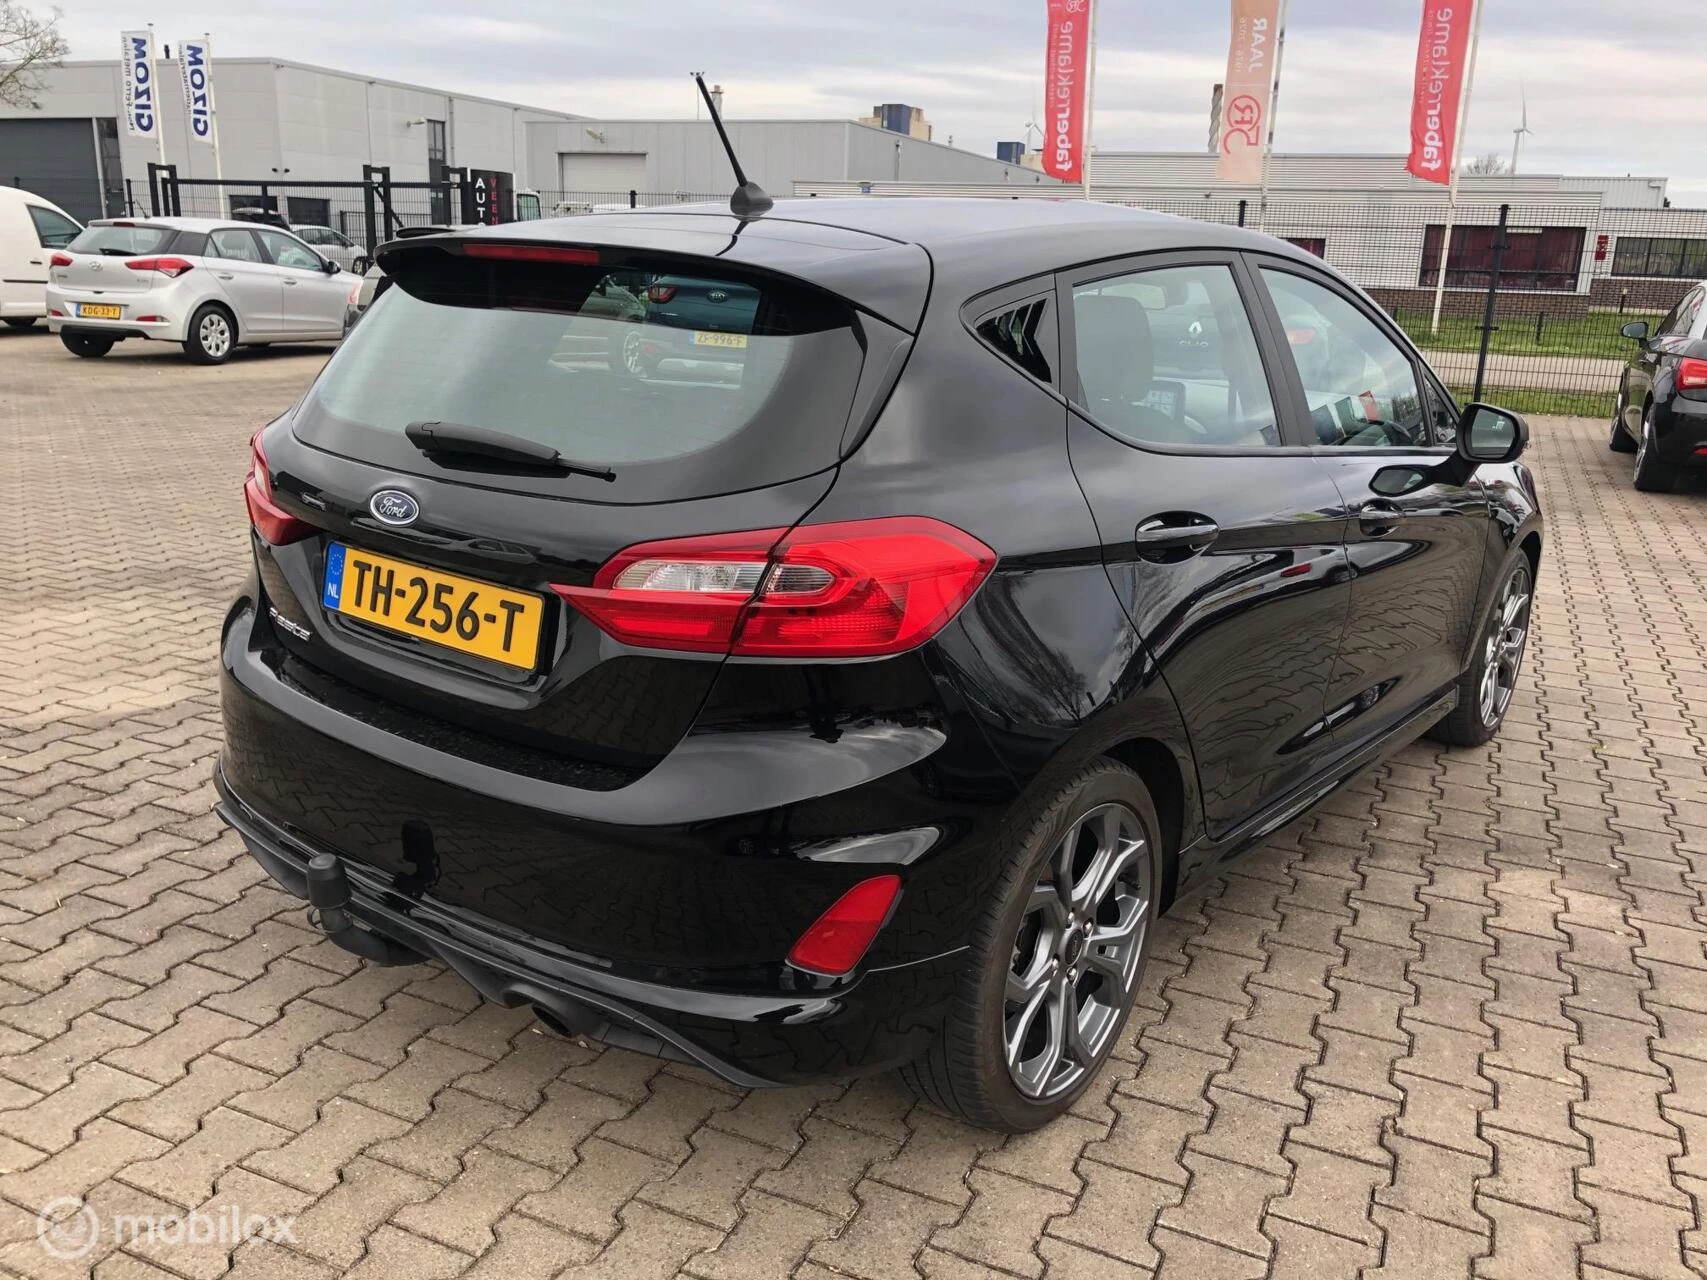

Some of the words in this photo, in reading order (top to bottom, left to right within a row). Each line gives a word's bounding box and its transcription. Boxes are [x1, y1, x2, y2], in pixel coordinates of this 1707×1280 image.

[82, 306, 117, 316] KDG-33-T
[380, 496, 407, 518] Ford
[328, 582, 339, 599] NL
[353, 559, 525, 652] TH-256-T
